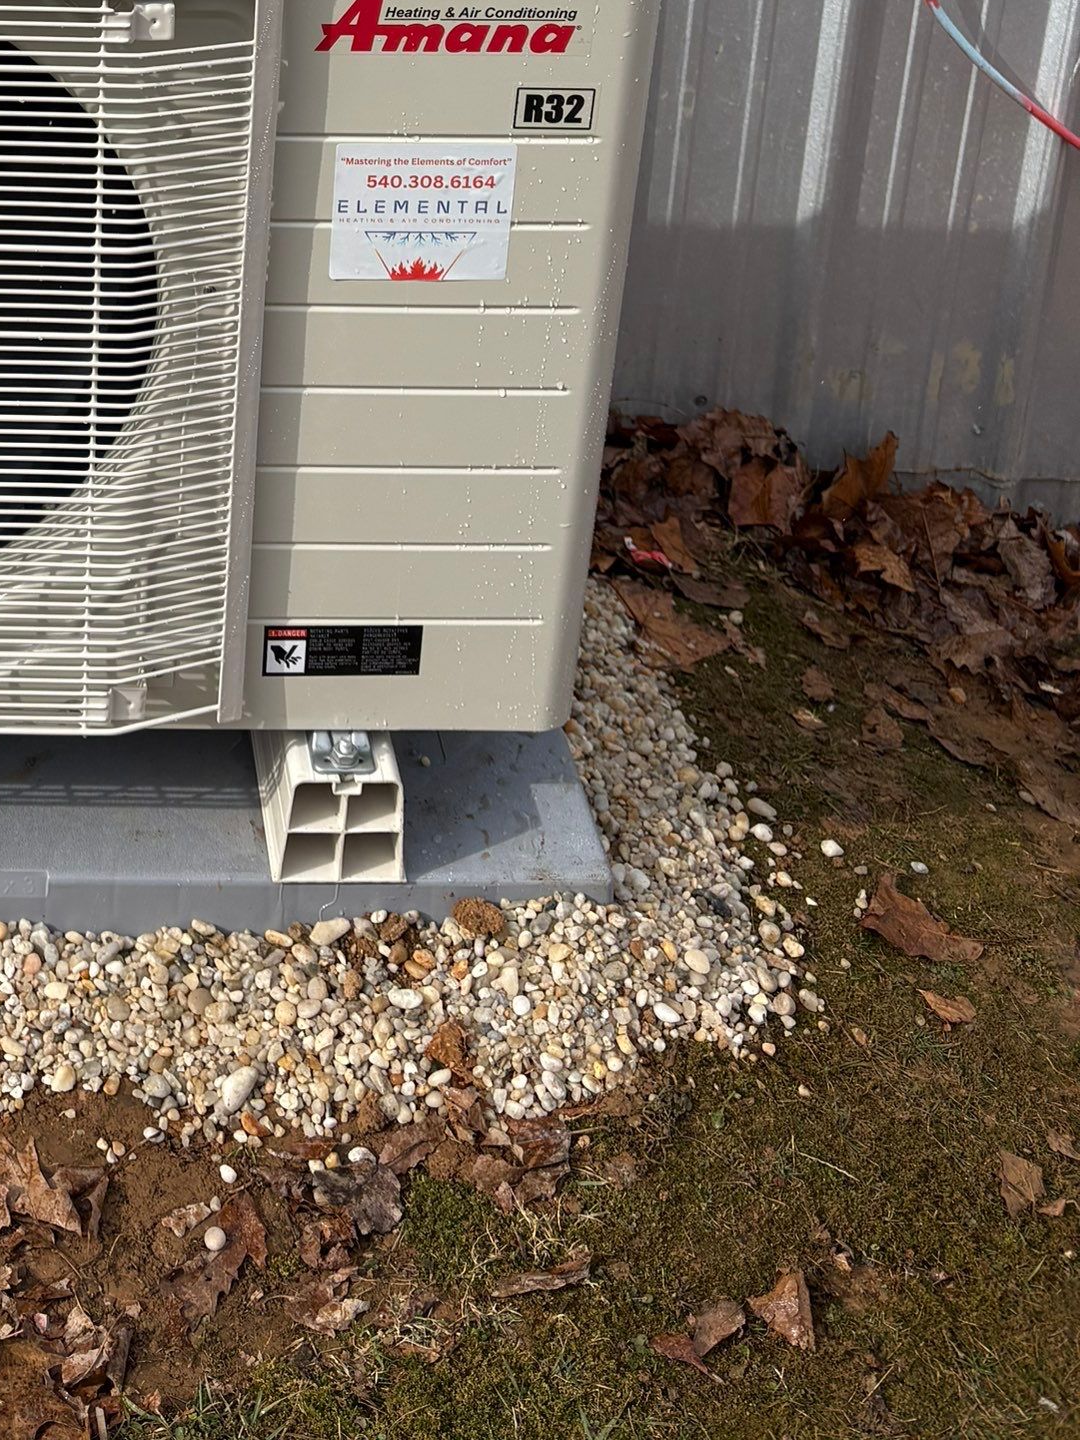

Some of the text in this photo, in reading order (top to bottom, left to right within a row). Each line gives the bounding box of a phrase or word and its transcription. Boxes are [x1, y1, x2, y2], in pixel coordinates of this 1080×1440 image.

[385, 6, 578, 22] Heating & Air Conditioning
[523, 94, 585, 123] R32
[393, 157, 410, 166] the
[411, 157, 455, 166] Elements
[456, 157, 466, 166] of
[366, 175, 497, 189] 540.308.6164
[337, 200, 508, 214] ELEMENTAL
[277, 629, 306, 638] DANGER
